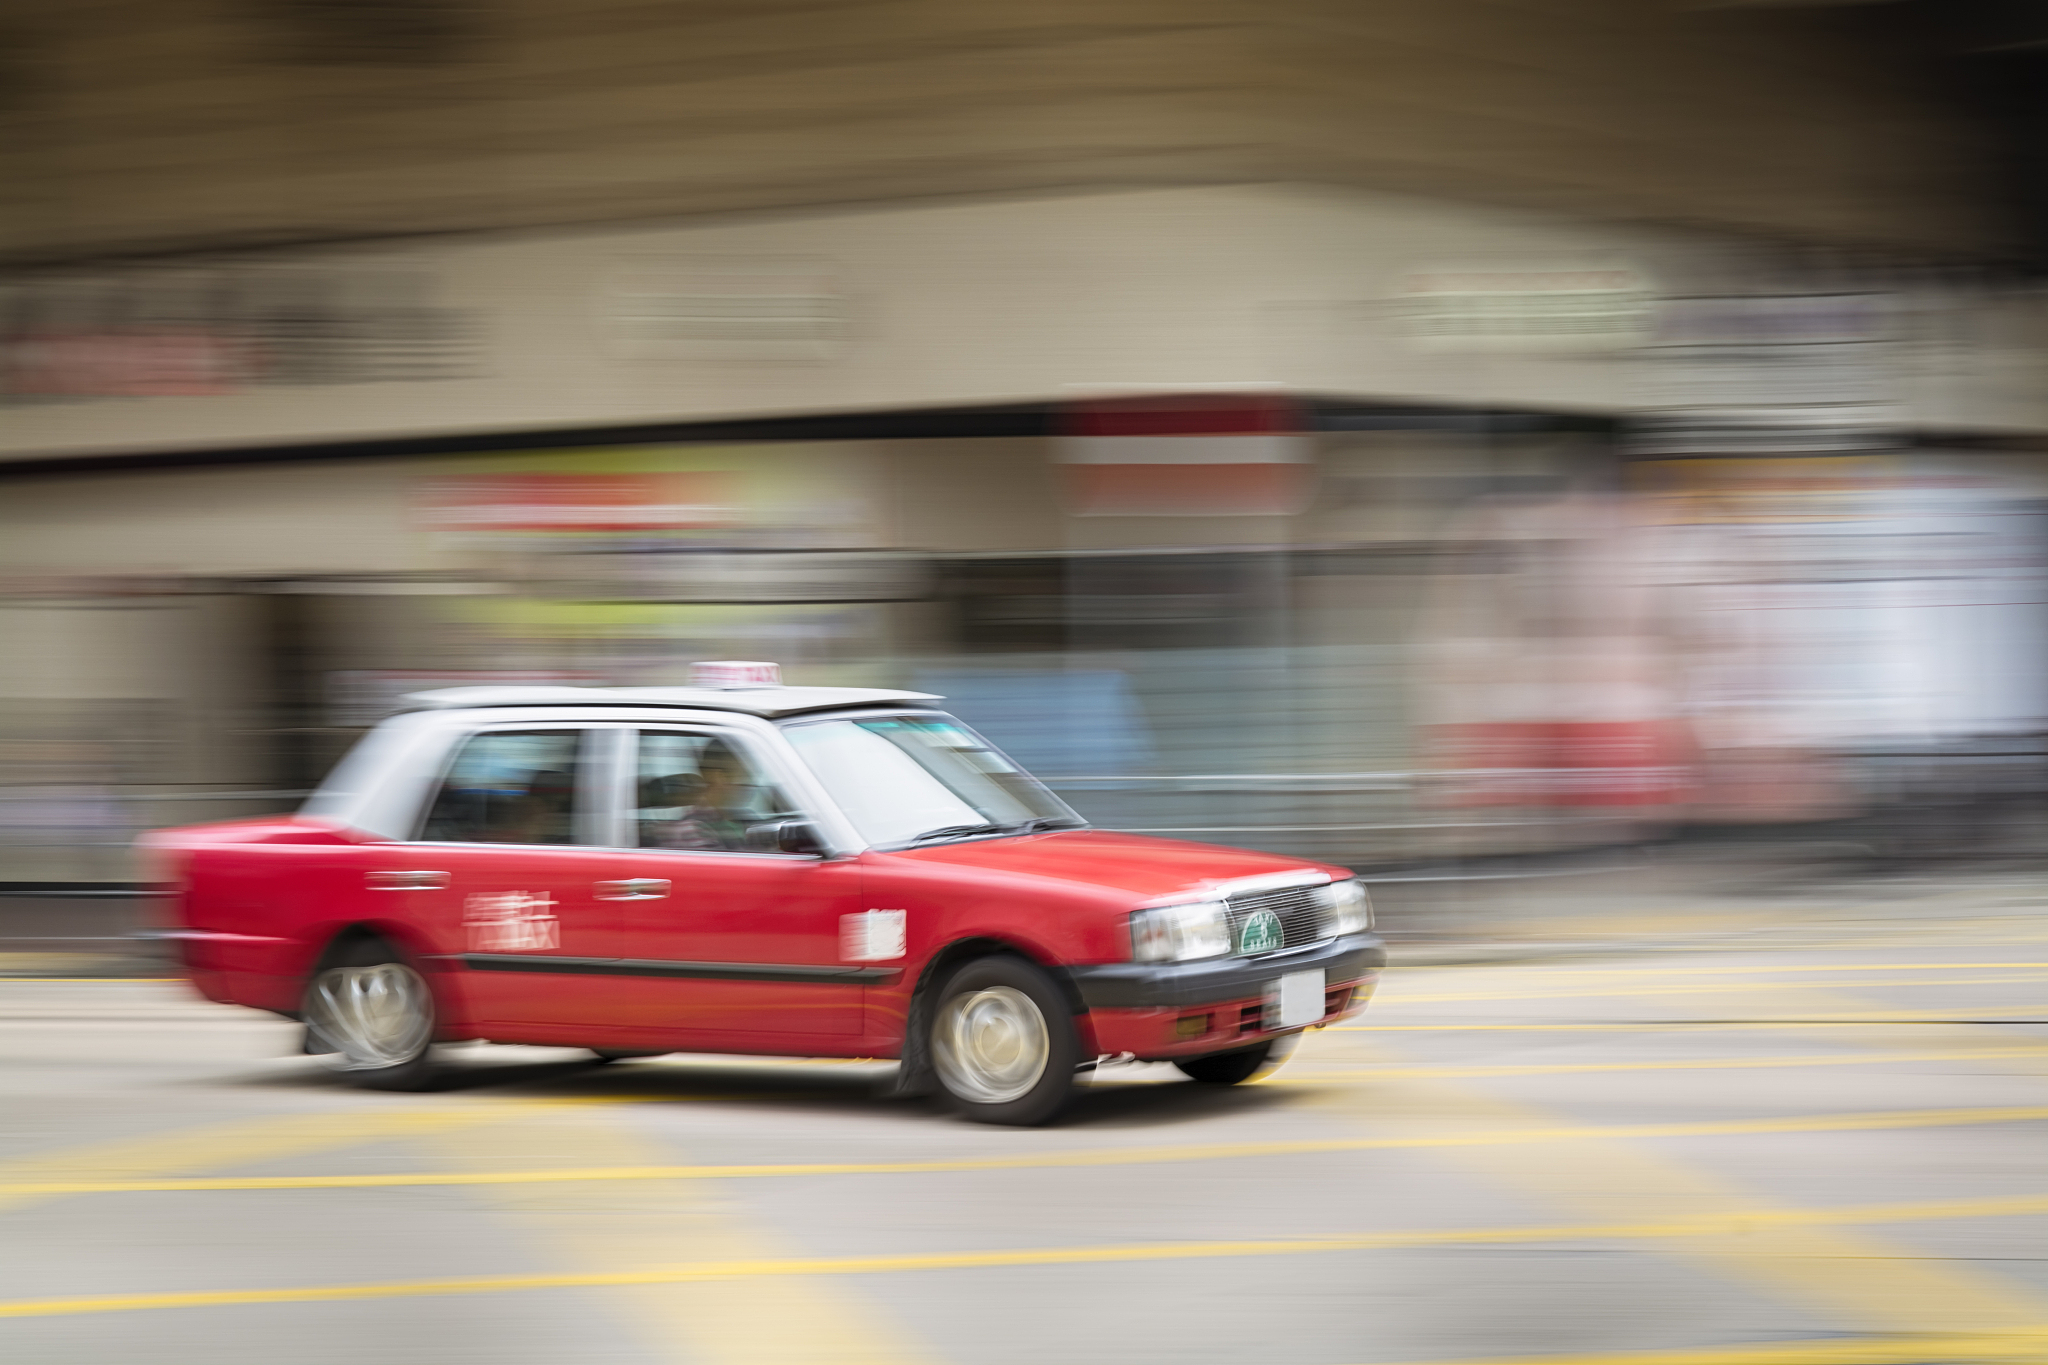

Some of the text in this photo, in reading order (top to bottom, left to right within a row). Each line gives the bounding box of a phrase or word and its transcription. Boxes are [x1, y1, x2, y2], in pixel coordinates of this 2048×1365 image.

[744, 666, 781, 683] TAXI
[1252, 912, 1273, 926] TAXI
[1249, 936, 1277, 950] SEATS
